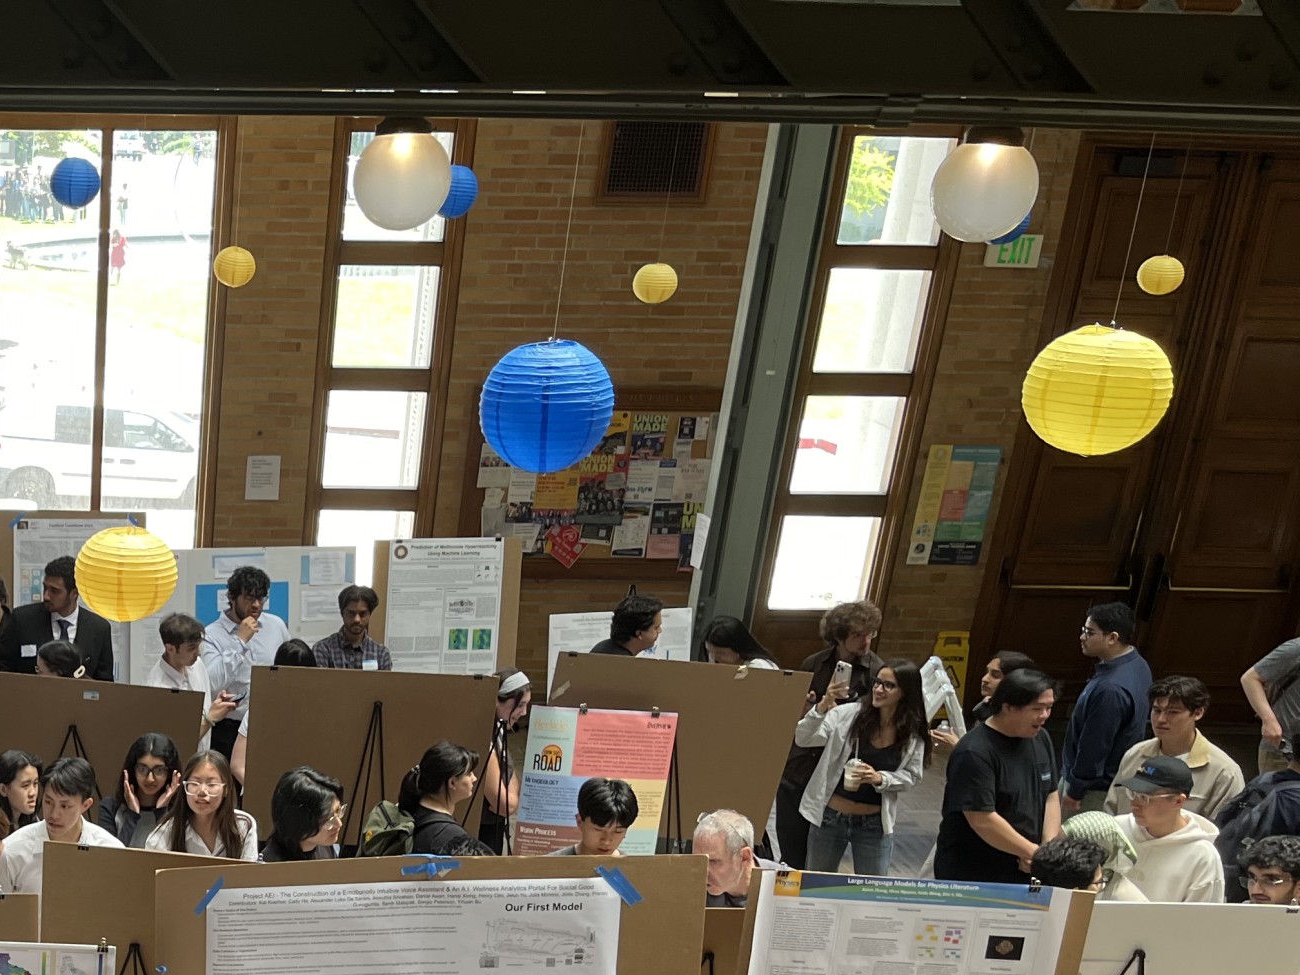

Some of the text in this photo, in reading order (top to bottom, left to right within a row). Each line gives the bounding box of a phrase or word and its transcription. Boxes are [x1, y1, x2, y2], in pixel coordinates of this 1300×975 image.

[997, 237, 1036, 264] EXIT
[634, 415, 669, 423] UNION
[632, 422, 668, 432] MADE
[581, 455, 615, 464] UNION
[580, 463, 614, 473] MADE
[534, 717, 570, 731] Berkeley
[533, 753, 562, 772] ROAD
[525, 776, 559, 785] METHODOLOGY
[534, 827, 557, 836] PROCESS
[775, 879, 800, 887] Physics
[848, 877, 863, 885] Large
[865, 879, 892, 888] Language
[927, 881, 949, 890] Physics
[505, 903, 582, 912] Our First Model
